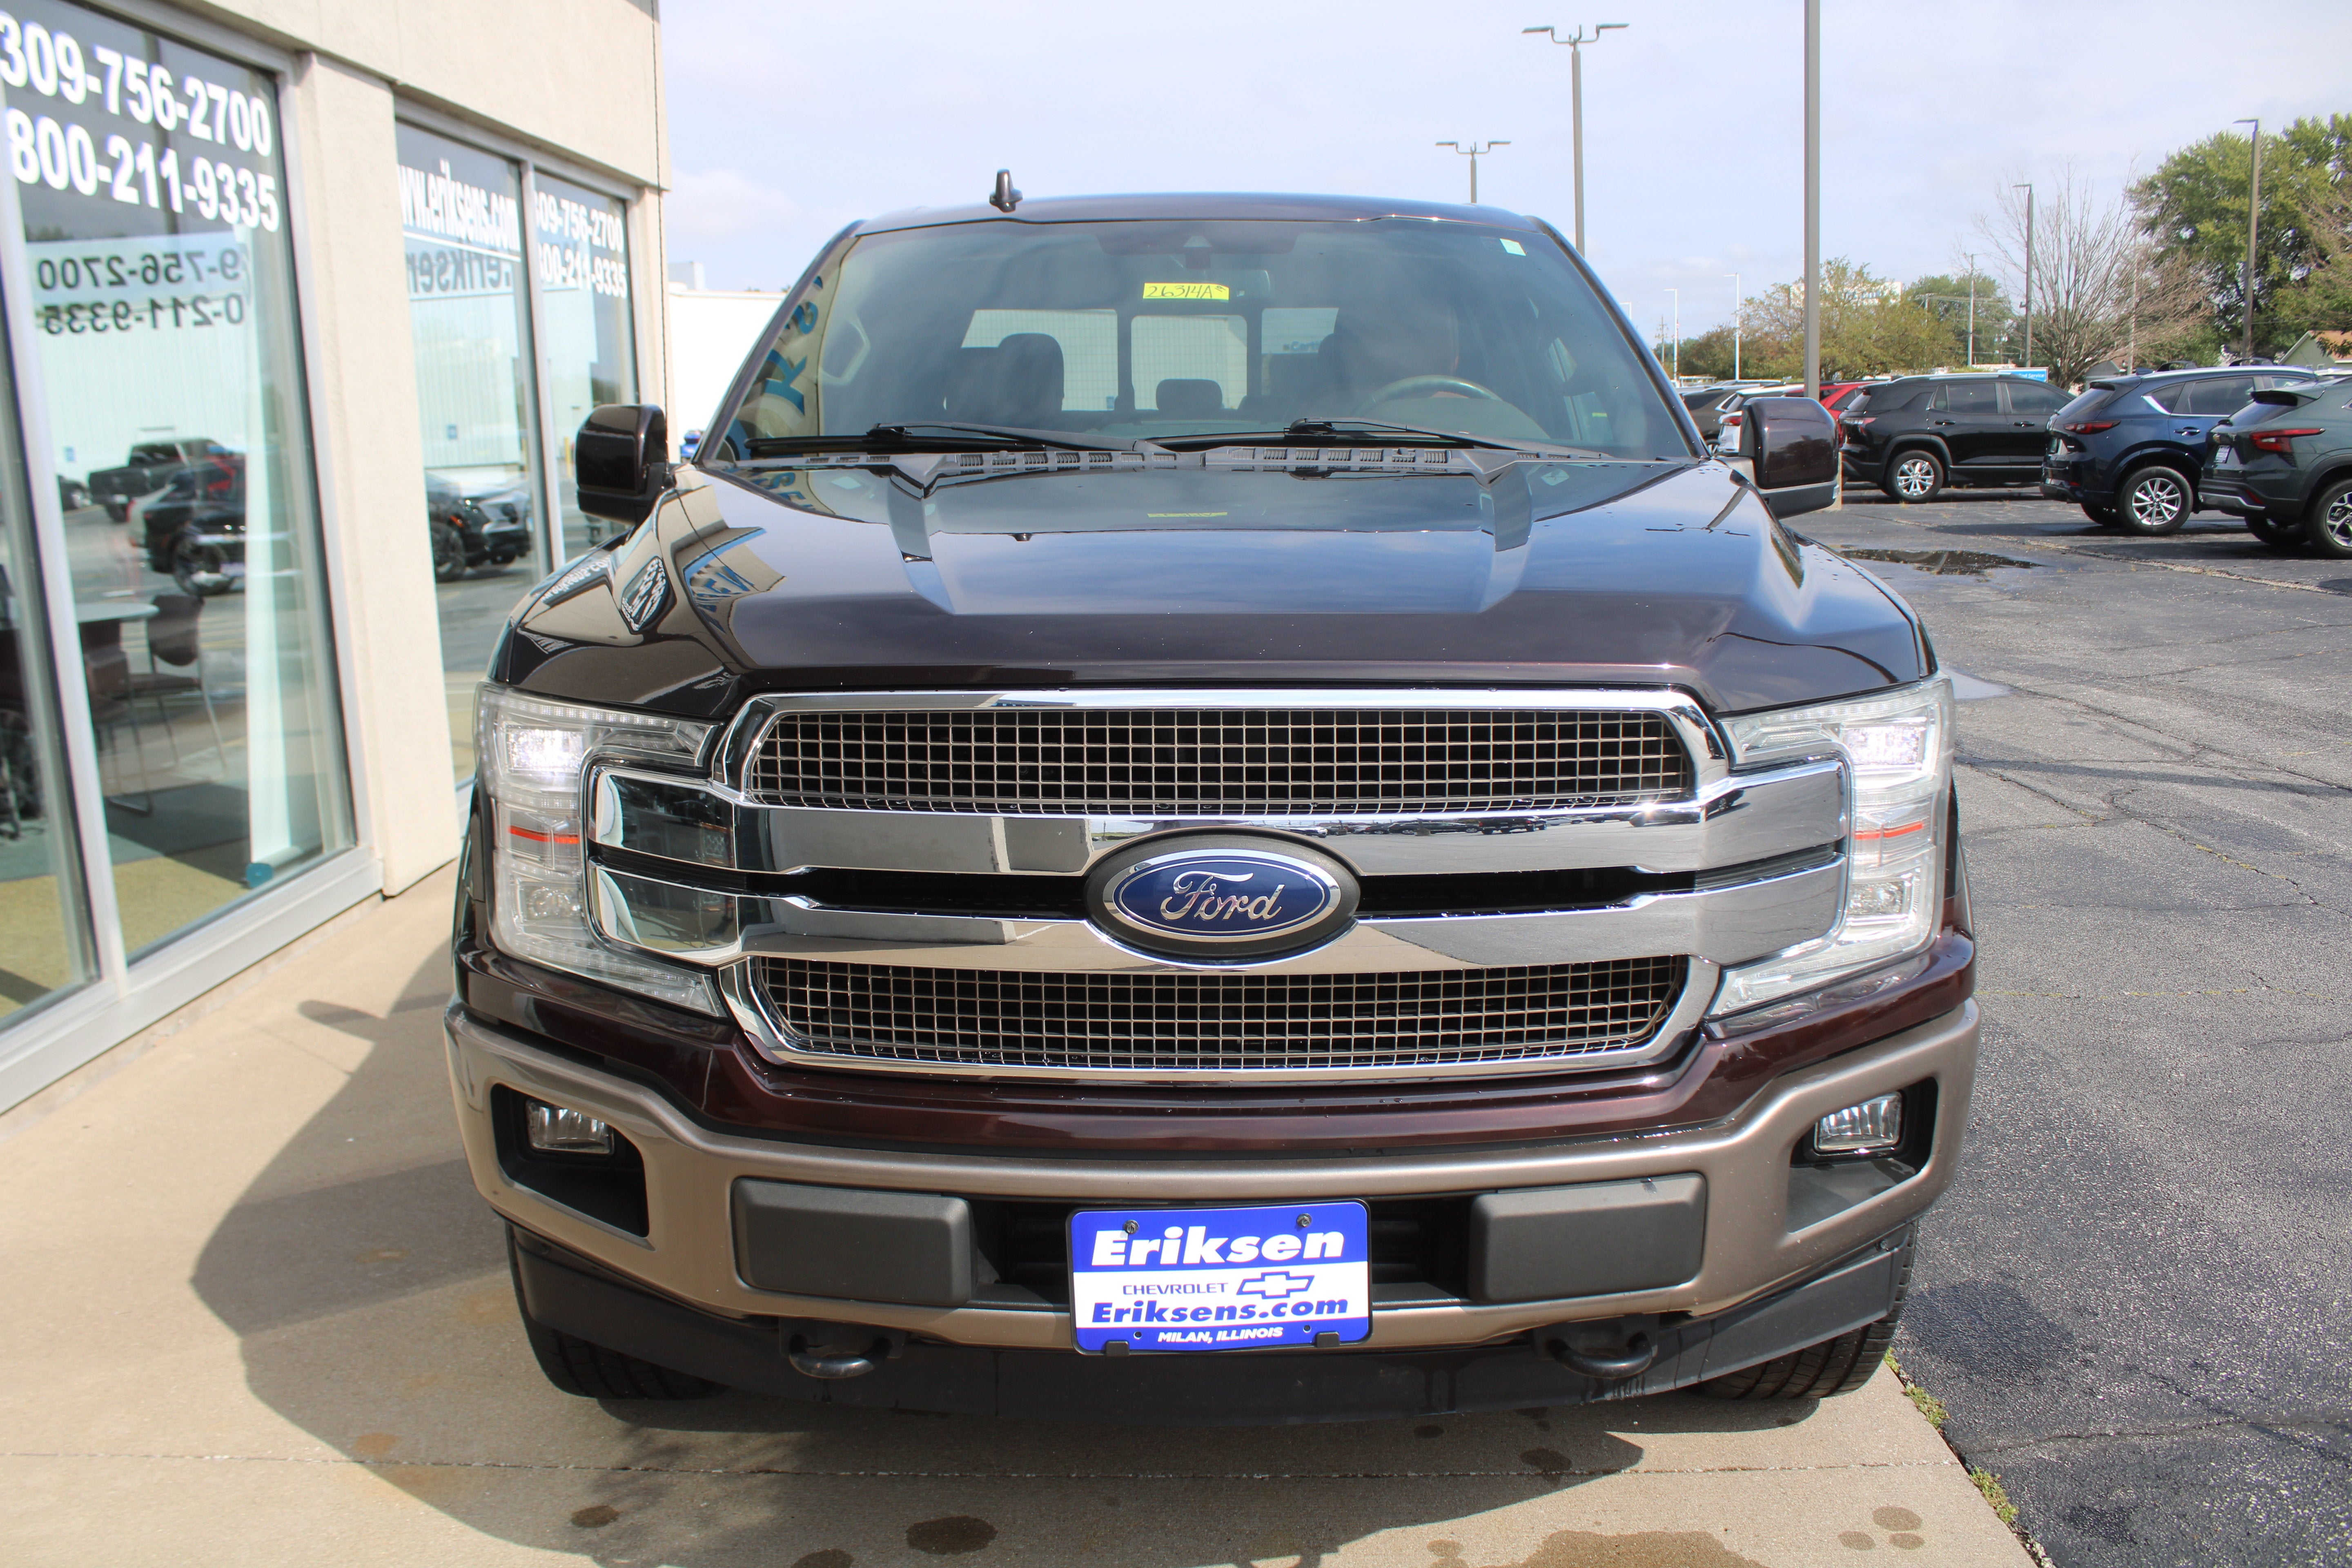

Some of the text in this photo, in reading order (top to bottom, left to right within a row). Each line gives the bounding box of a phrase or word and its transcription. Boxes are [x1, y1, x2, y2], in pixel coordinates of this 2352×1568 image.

[0, 11, 272, 157] 309-756-2700
[5, 107, 280, 232] 800-211-9335
[1146, 285, 1212, 298] 26314A
[1160, 870, 1285, 921] Ford
[1091, 1225, 1345, 1266] Eriksen
[1122, 1282, 1229, 1295] CHEVROLET
[1091, 1298, 1349, 1323] Eriksens.com
[1158, 1327, 1283, 1344] MILAN, ILLINOIS
